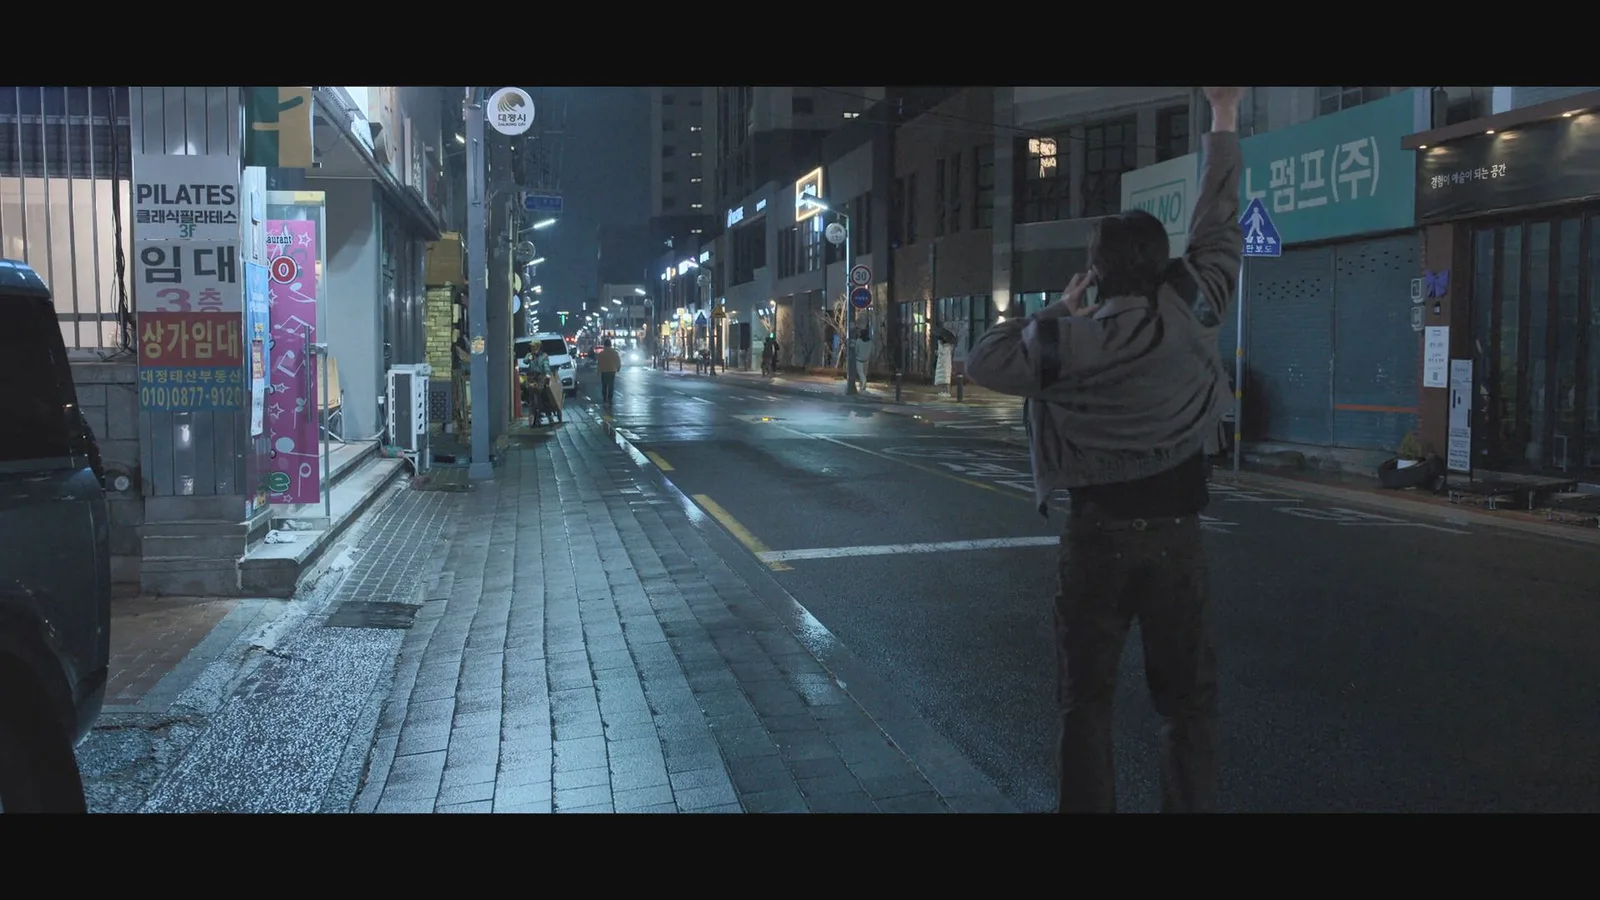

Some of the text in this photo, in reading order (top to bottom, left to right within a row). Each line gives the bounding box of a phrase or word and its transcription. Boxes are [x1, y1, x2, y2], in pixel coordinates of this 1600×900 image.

[1431, 163, 1507, 189] 경험이 예술이 되는 공간
[137, 184, 236, 205] PILATES
[137, 209, 237, 224] 클래식필라테스
[180, 224, 196, 238] 3F
[855, 271, 868, 281] 30
[142, 320, 239, 359] 상가임대
